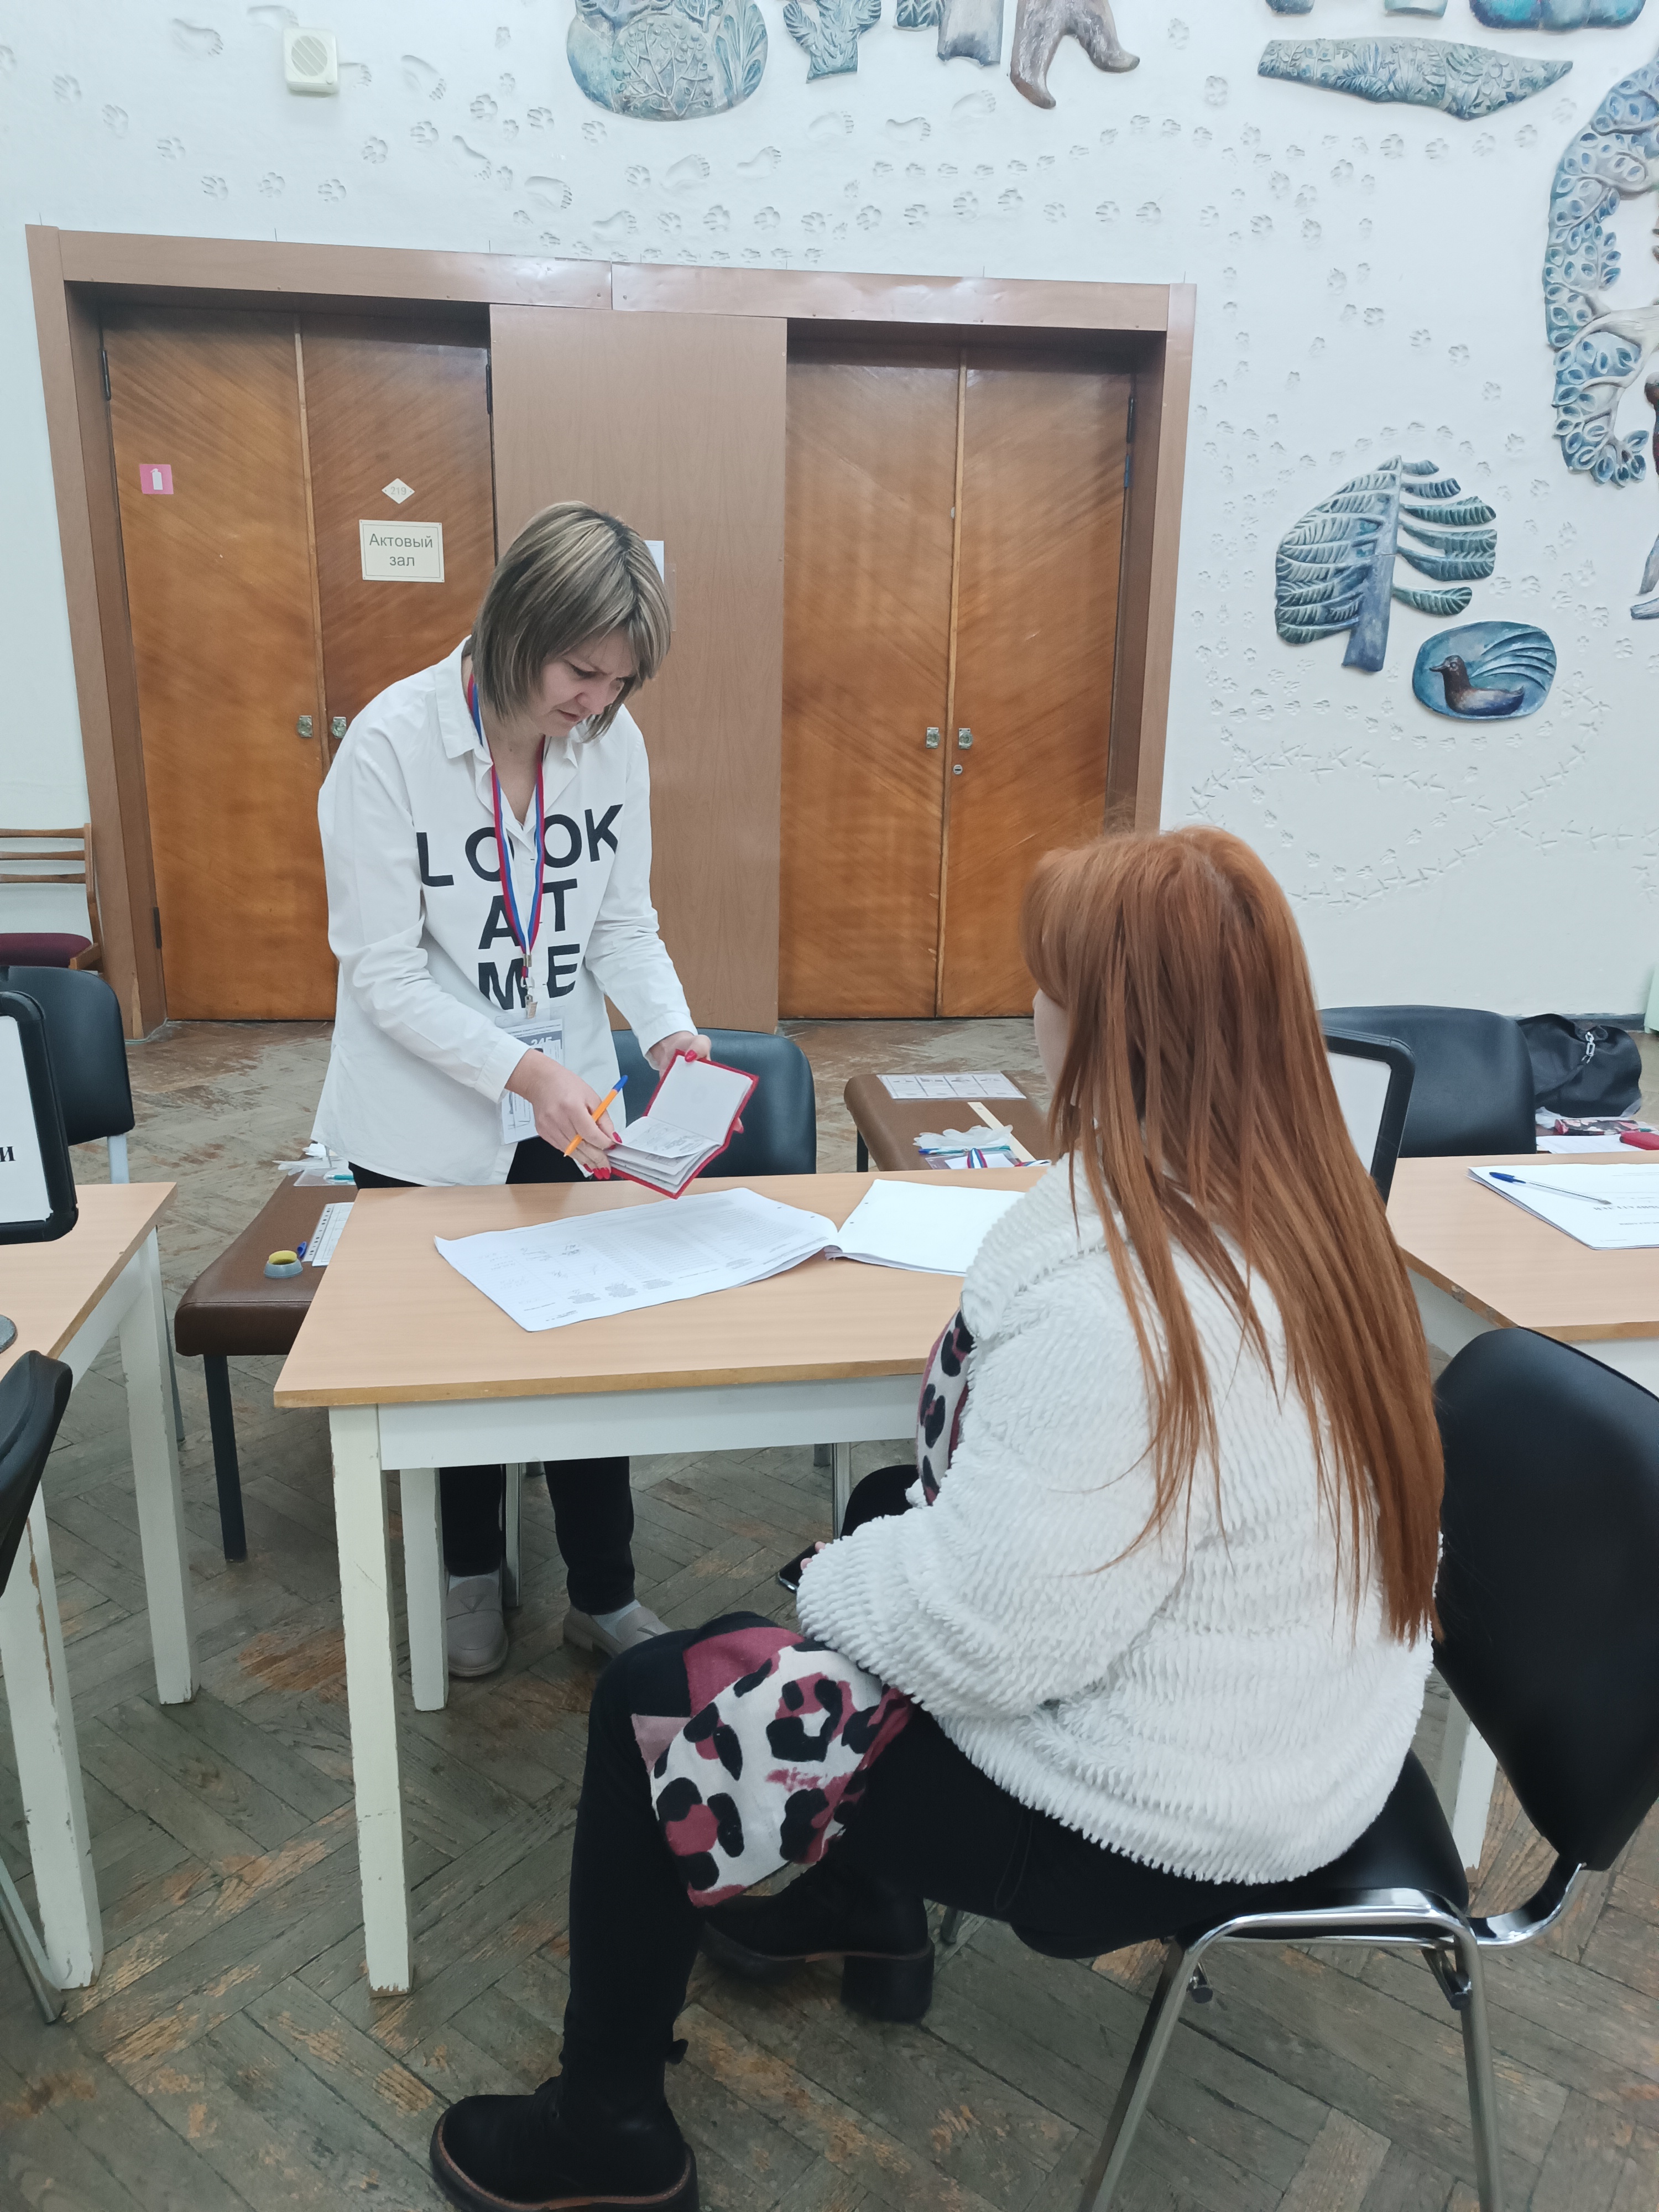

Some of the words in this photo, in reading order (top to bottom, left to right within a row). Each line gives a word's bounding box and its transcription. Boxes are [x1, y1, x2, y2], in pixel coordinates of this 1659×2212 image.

[390, 487, 407, 495] 219
[369, 534, 432, 548] Актовый
[389, 556, 415, 566] зал
[416, 804, 623, 887] LOOK
[478, 878, 578, 950] AT
[478, 943, 580, 1010] ME
